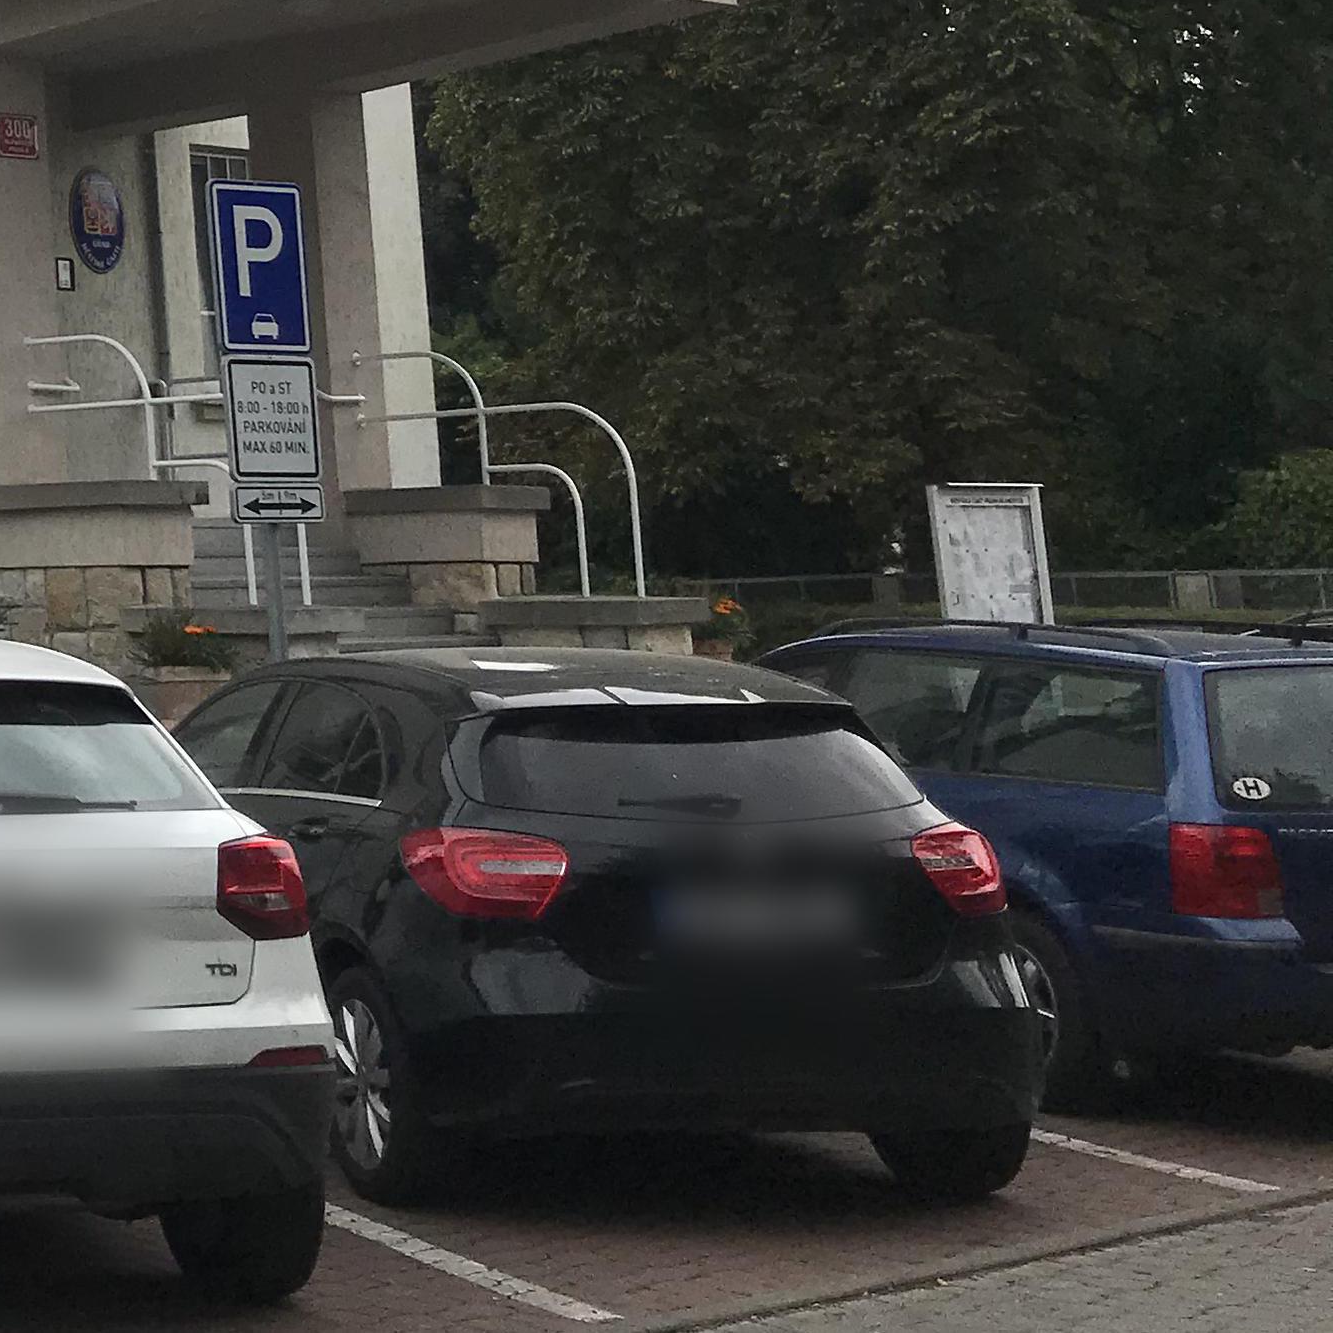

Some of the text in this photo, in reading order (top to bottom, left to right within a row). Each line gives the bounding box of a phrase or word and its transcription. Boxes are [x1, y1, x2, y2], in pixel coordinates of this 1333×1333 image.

[4, 118, 31, 139] 300
[233, 204, 284, 297] P
[250, 380, 266, 395] PO
[269, 384, 275, 395] a
[237, 400, 260, 414] 8:00
[271, 401, 300, 415] 18:00
[302, 402, 309, 415] h
[243, 418, 307, 434] PARKOVÁNÍ
[242, 440, 268, 454] MAX
[270, 441, 282, 454] 60
[1242, 779, 1262, 797] H
[204, 963, 237, 977] TDI
